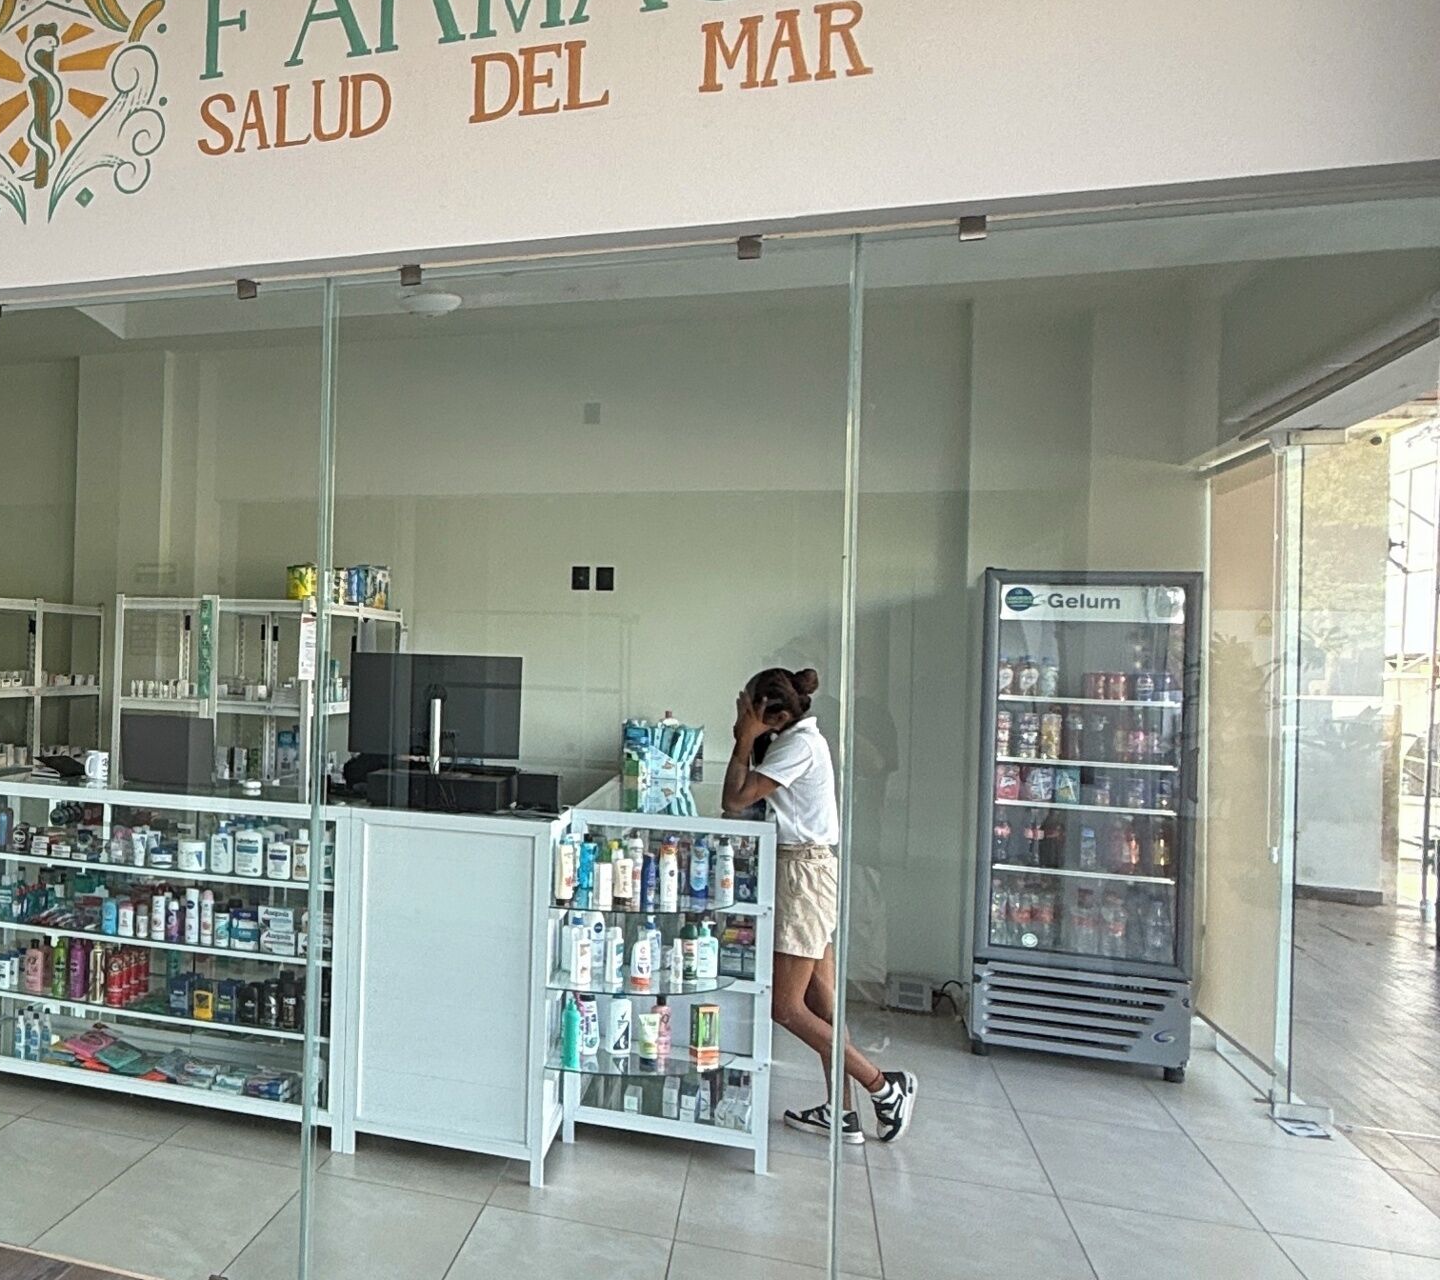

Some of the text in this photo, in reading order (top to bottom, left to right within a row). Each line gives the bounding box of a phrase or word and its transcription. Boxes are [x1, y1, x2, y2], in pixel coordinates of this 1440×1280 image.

[197, 0, 874, 157] SALUD DEL MAR
[1047, 592, 1121, 610] Gelum
